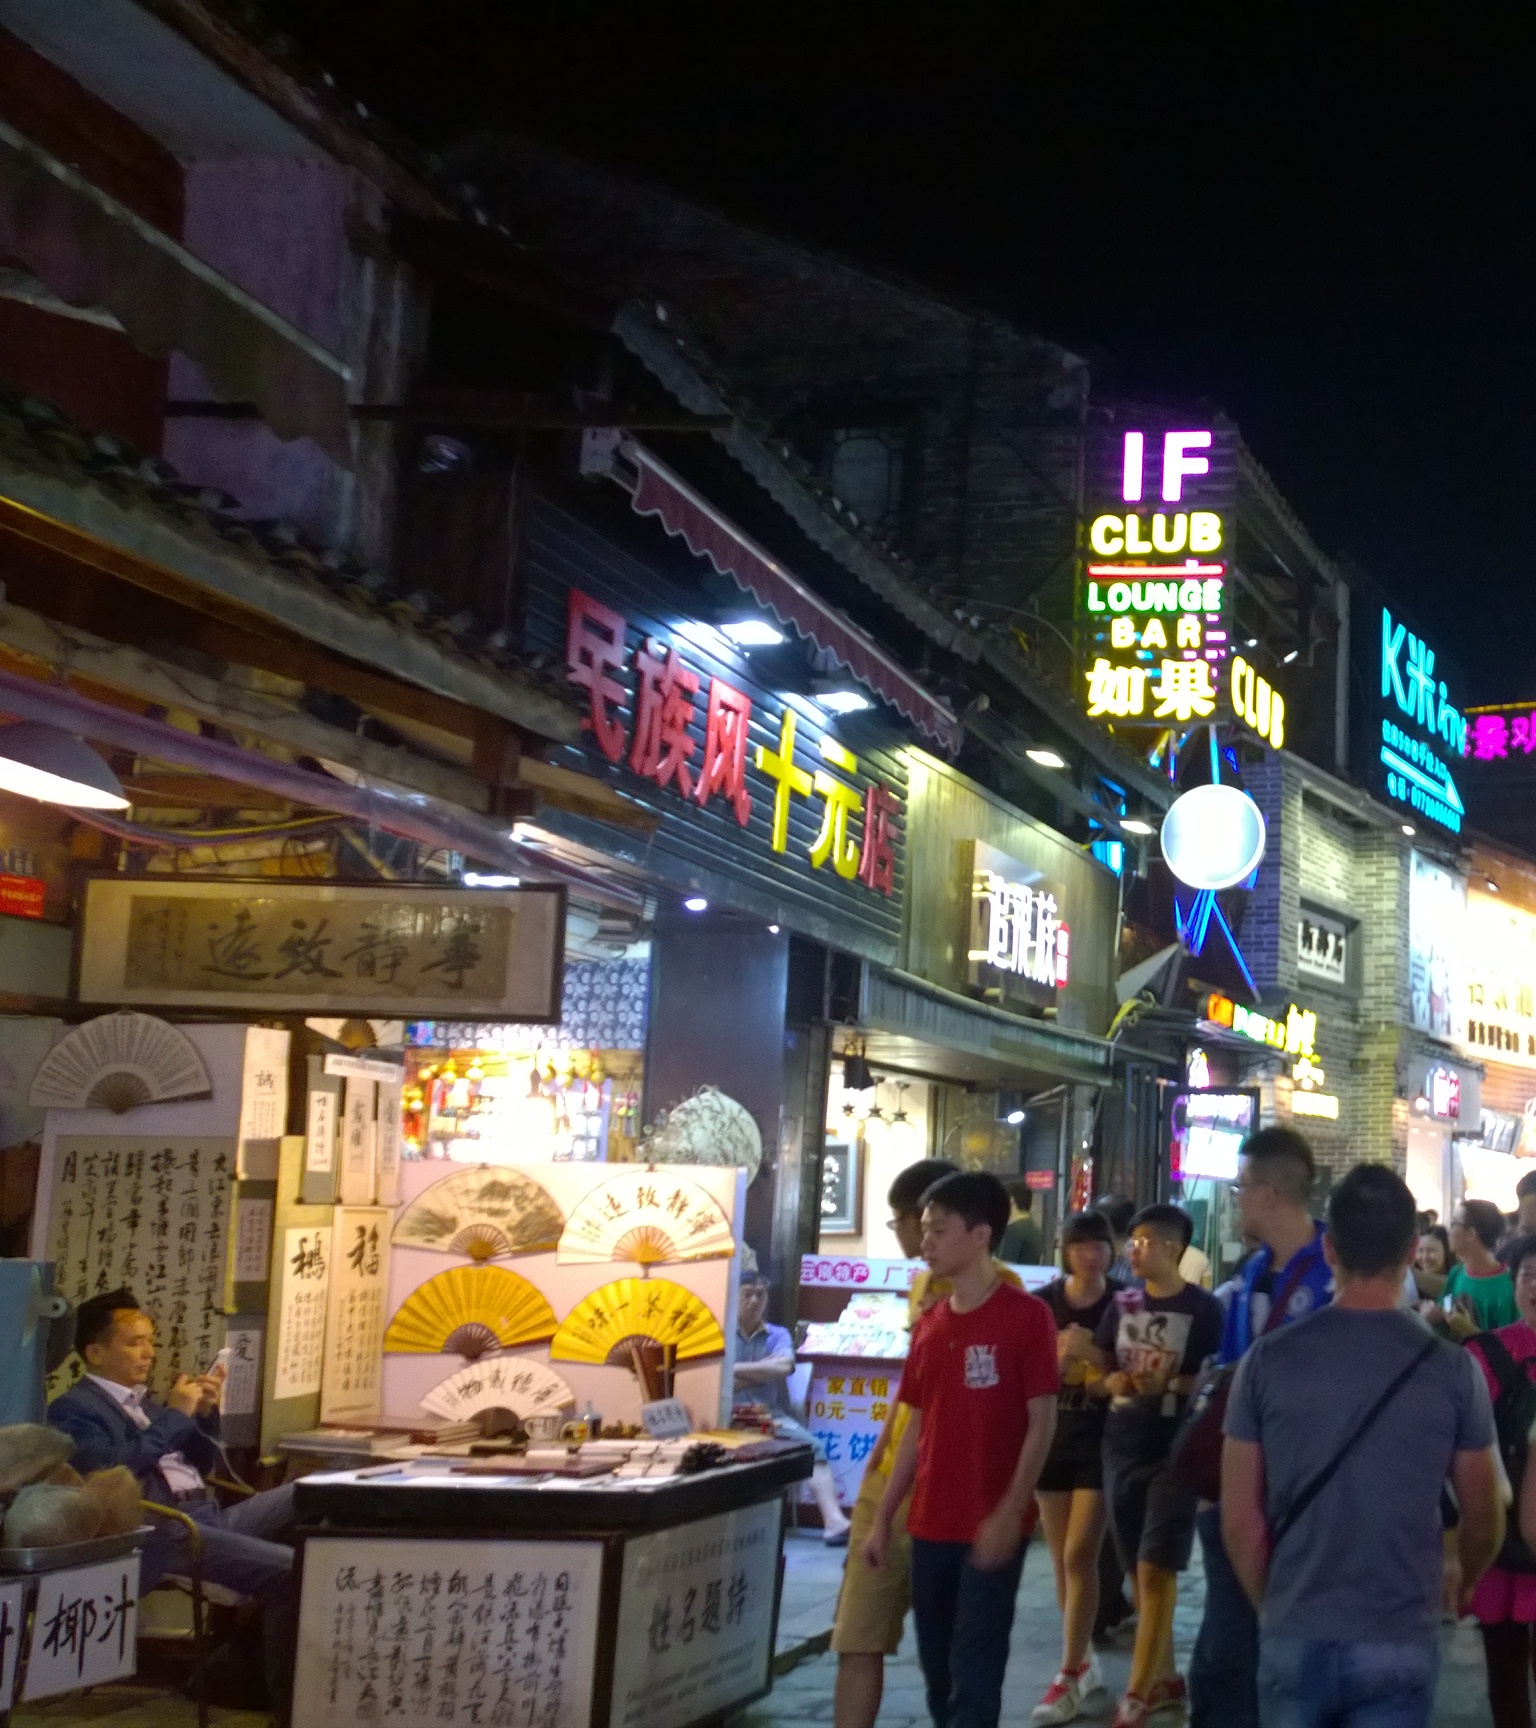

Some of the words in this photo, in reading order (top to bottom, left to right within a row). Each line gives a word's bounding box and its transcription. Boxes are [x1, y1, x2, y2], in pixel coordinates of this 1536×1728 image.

[1121, 430, 1212, 502] IF
[1090, 512, 1222, 556] CLUB
[1087, 579, 1223, 612] LOUNGE
[1110, 617, 1202, 648] BAR
[1085, 657, 1216, 721] 如果
[1230, 655, 1285, 749] CLUB
[566, 587, 901, 898] 民族风十元店
[42, 1573, 135, 1680] 椰汁
